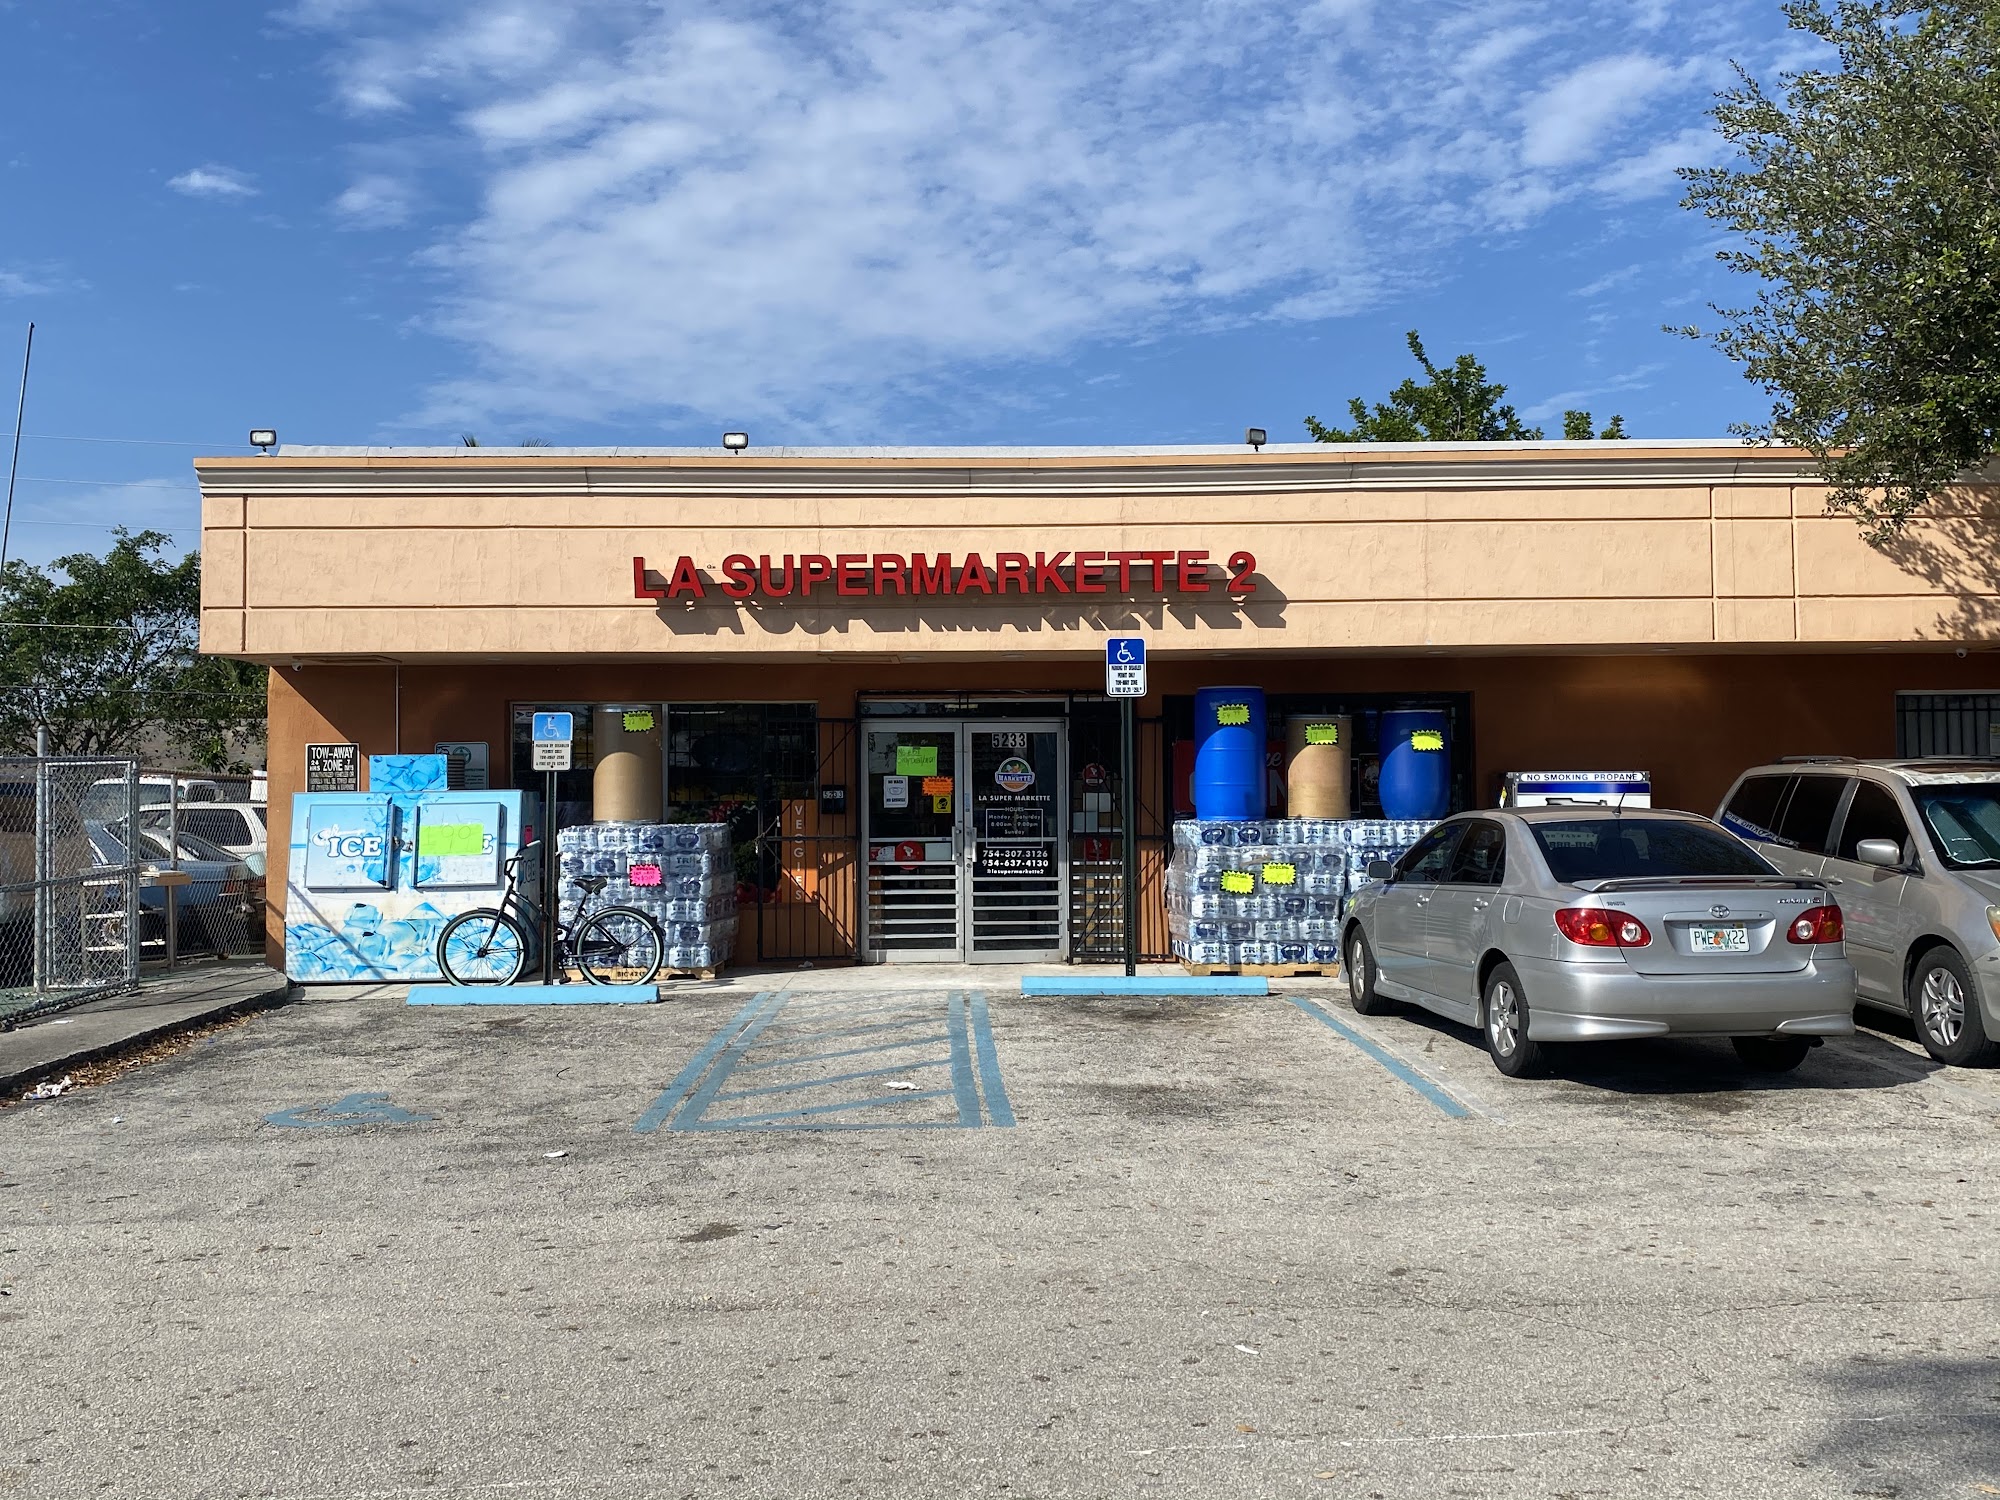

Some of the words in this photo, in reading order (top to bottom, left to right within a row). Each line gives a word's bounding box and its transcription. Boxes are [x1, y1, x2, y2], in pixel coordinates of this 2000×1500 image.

[633, 556, 706, 598] LA
[721, 551, 1210, 598] SUPERMARKETTE
[1227, 551, 1257, 593] 2
[992, 732, 1026, 748] 5233
[311, 746, 354, 759] TOW-AWAY
[322, 759, 343, 771] ZONE
[327, 836, 382, 858] ICE
[1694, 930, 1714, 945] PWE
[1726, 930, 1746, 945] X22
